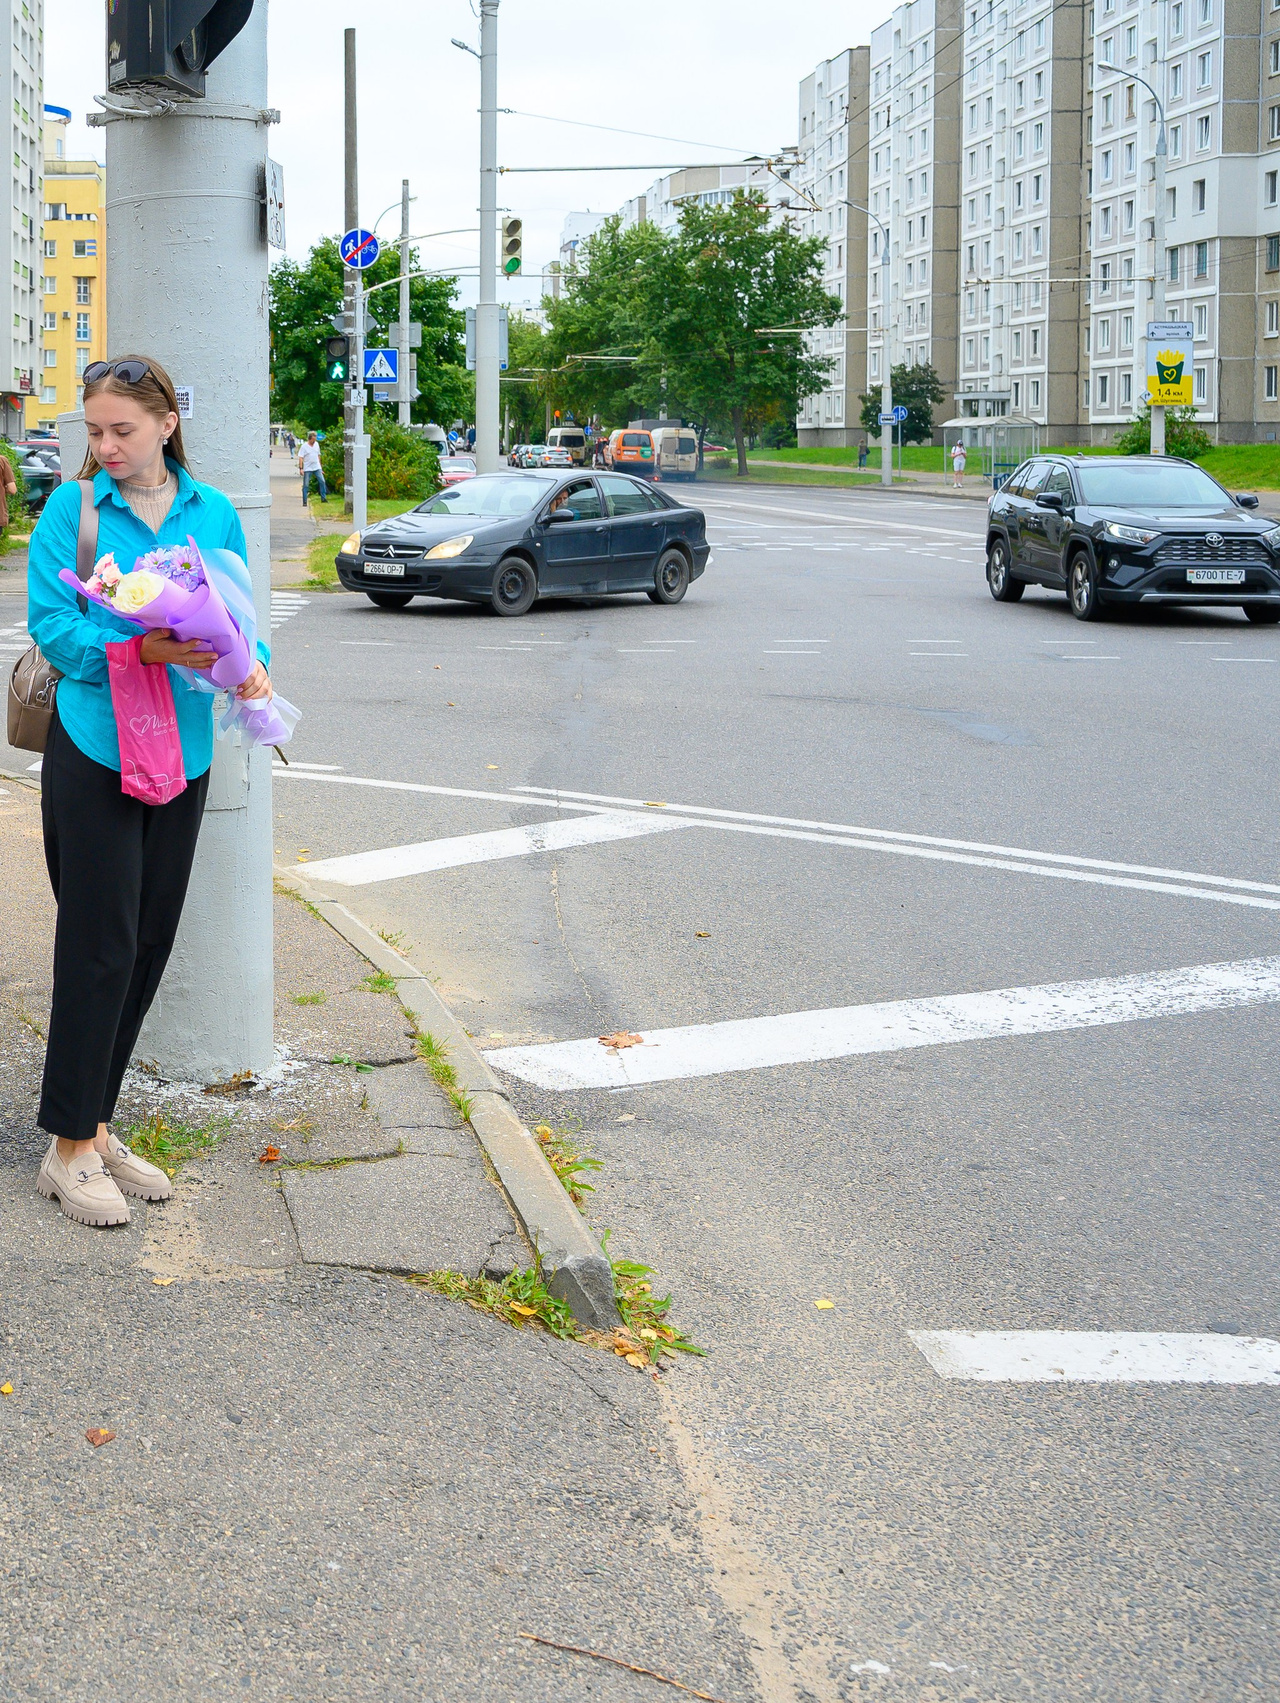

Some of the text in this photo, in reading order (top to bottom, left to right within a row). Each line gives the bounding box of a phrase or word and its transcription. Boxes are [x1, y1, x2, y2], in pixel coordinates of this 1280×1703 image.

[1157, 388, 1171, 398] 1,4
[1195, 570, 1244, 580] 6700 TE-7
